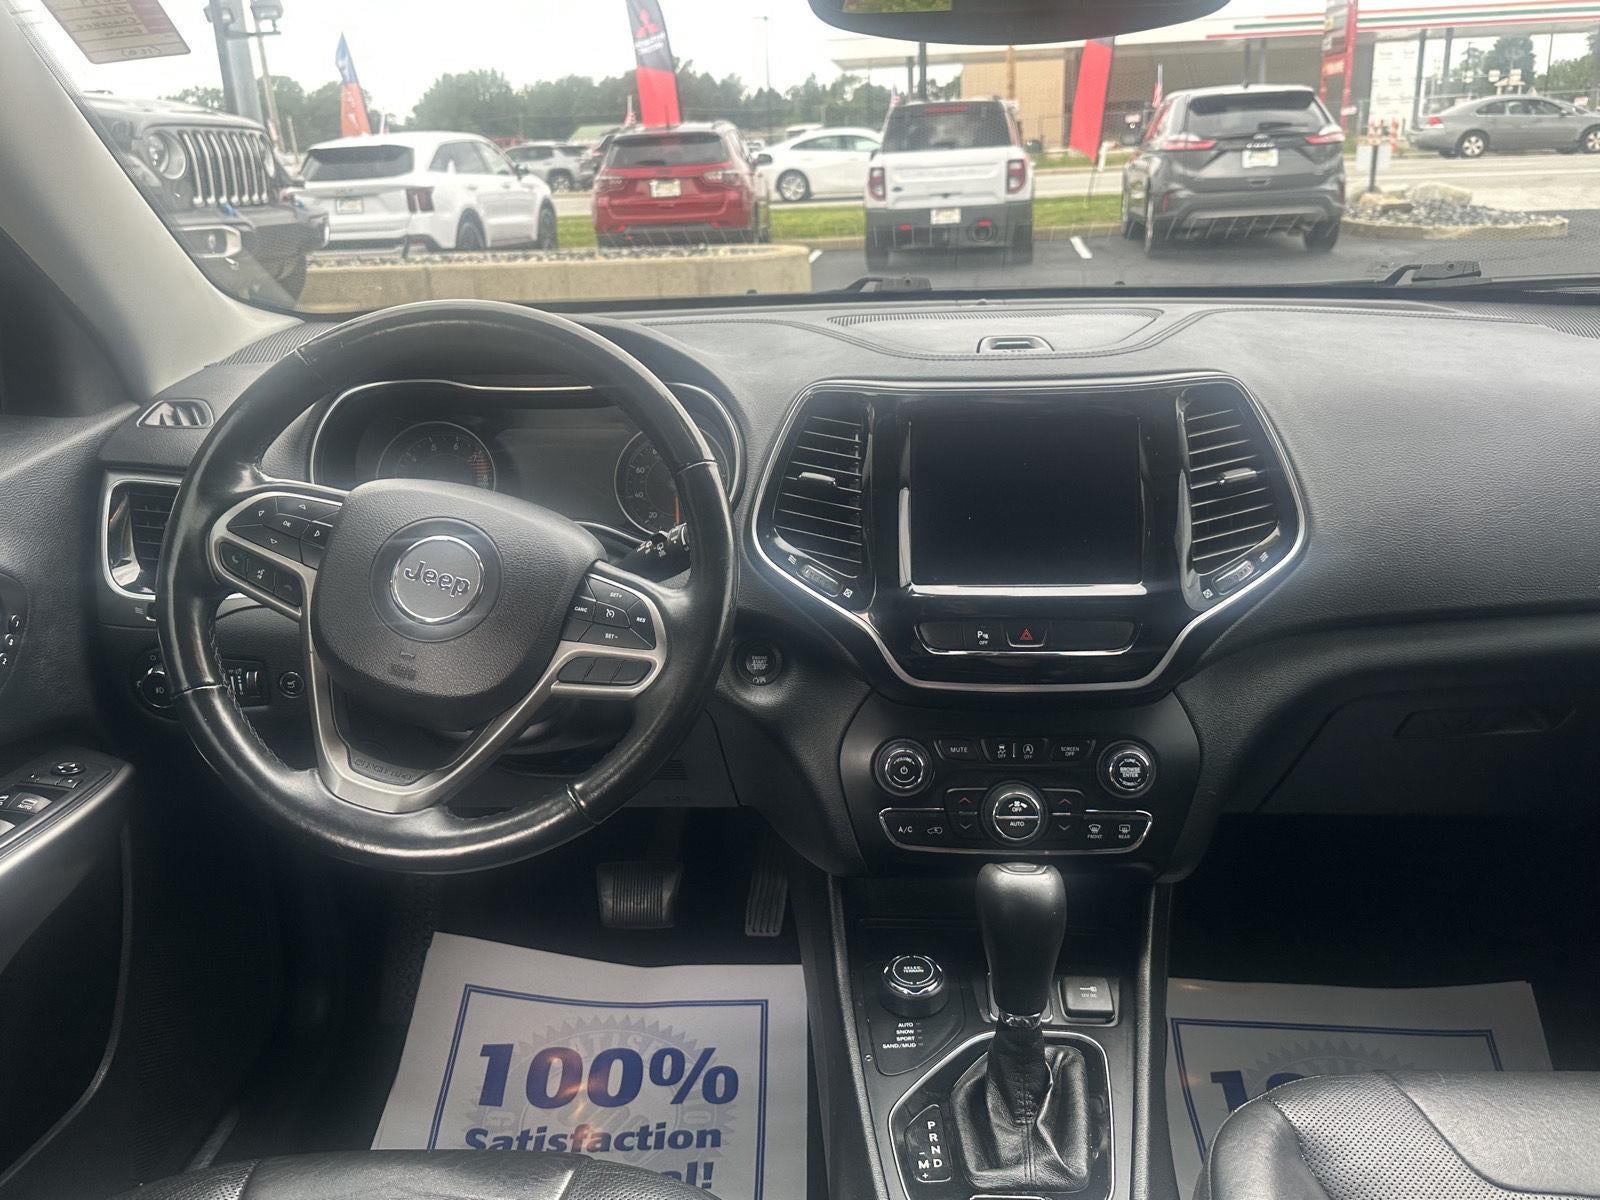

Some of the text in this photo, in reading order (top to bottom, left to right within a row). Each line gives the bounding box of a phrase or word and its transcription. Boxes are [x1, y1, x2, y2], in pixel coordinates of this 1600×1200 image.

[404, 560, 471, 598] Jeep
[898, 825, 913, 834] A/C
[478, 1043, 739, 1110] 100%
[927, 1121, 936, 1130] P
[464, 1121, 722, 1154] Satisfaction
[928, 1133, 938, 1142] R
[930, 1145, 941, 1155] N
[917, 1158, 943, 1169] M D
